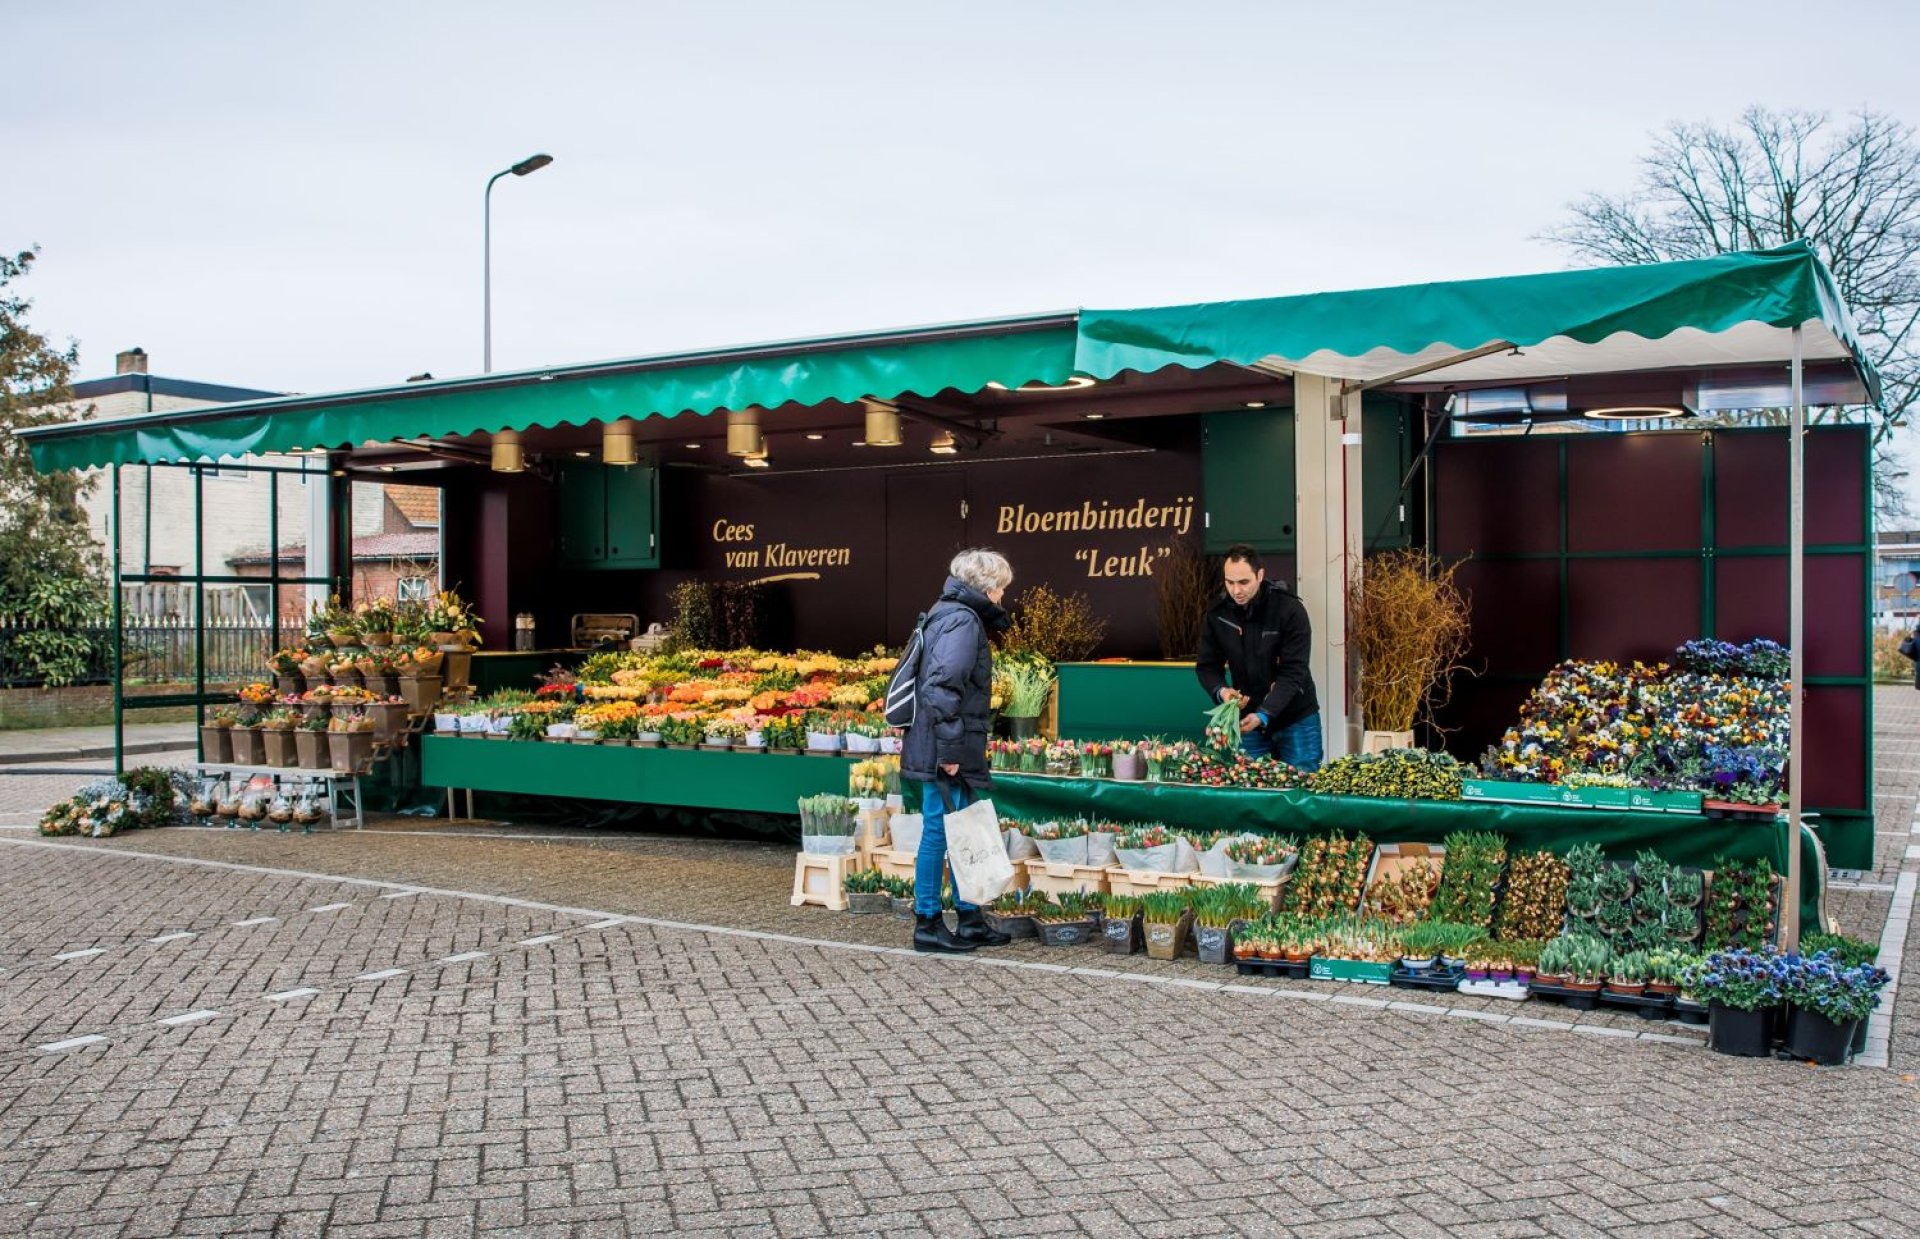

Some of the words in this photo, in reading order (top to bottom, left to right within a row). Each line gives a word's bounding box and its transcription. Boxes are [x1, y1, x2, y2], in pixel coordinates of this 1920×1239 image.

[996, 496, 1194, 535] Bloembinderij
[713, 519, 754, 542] Cees
[725, 550, 759, 568] van
[764, 542, 850, 567] Klaveren
